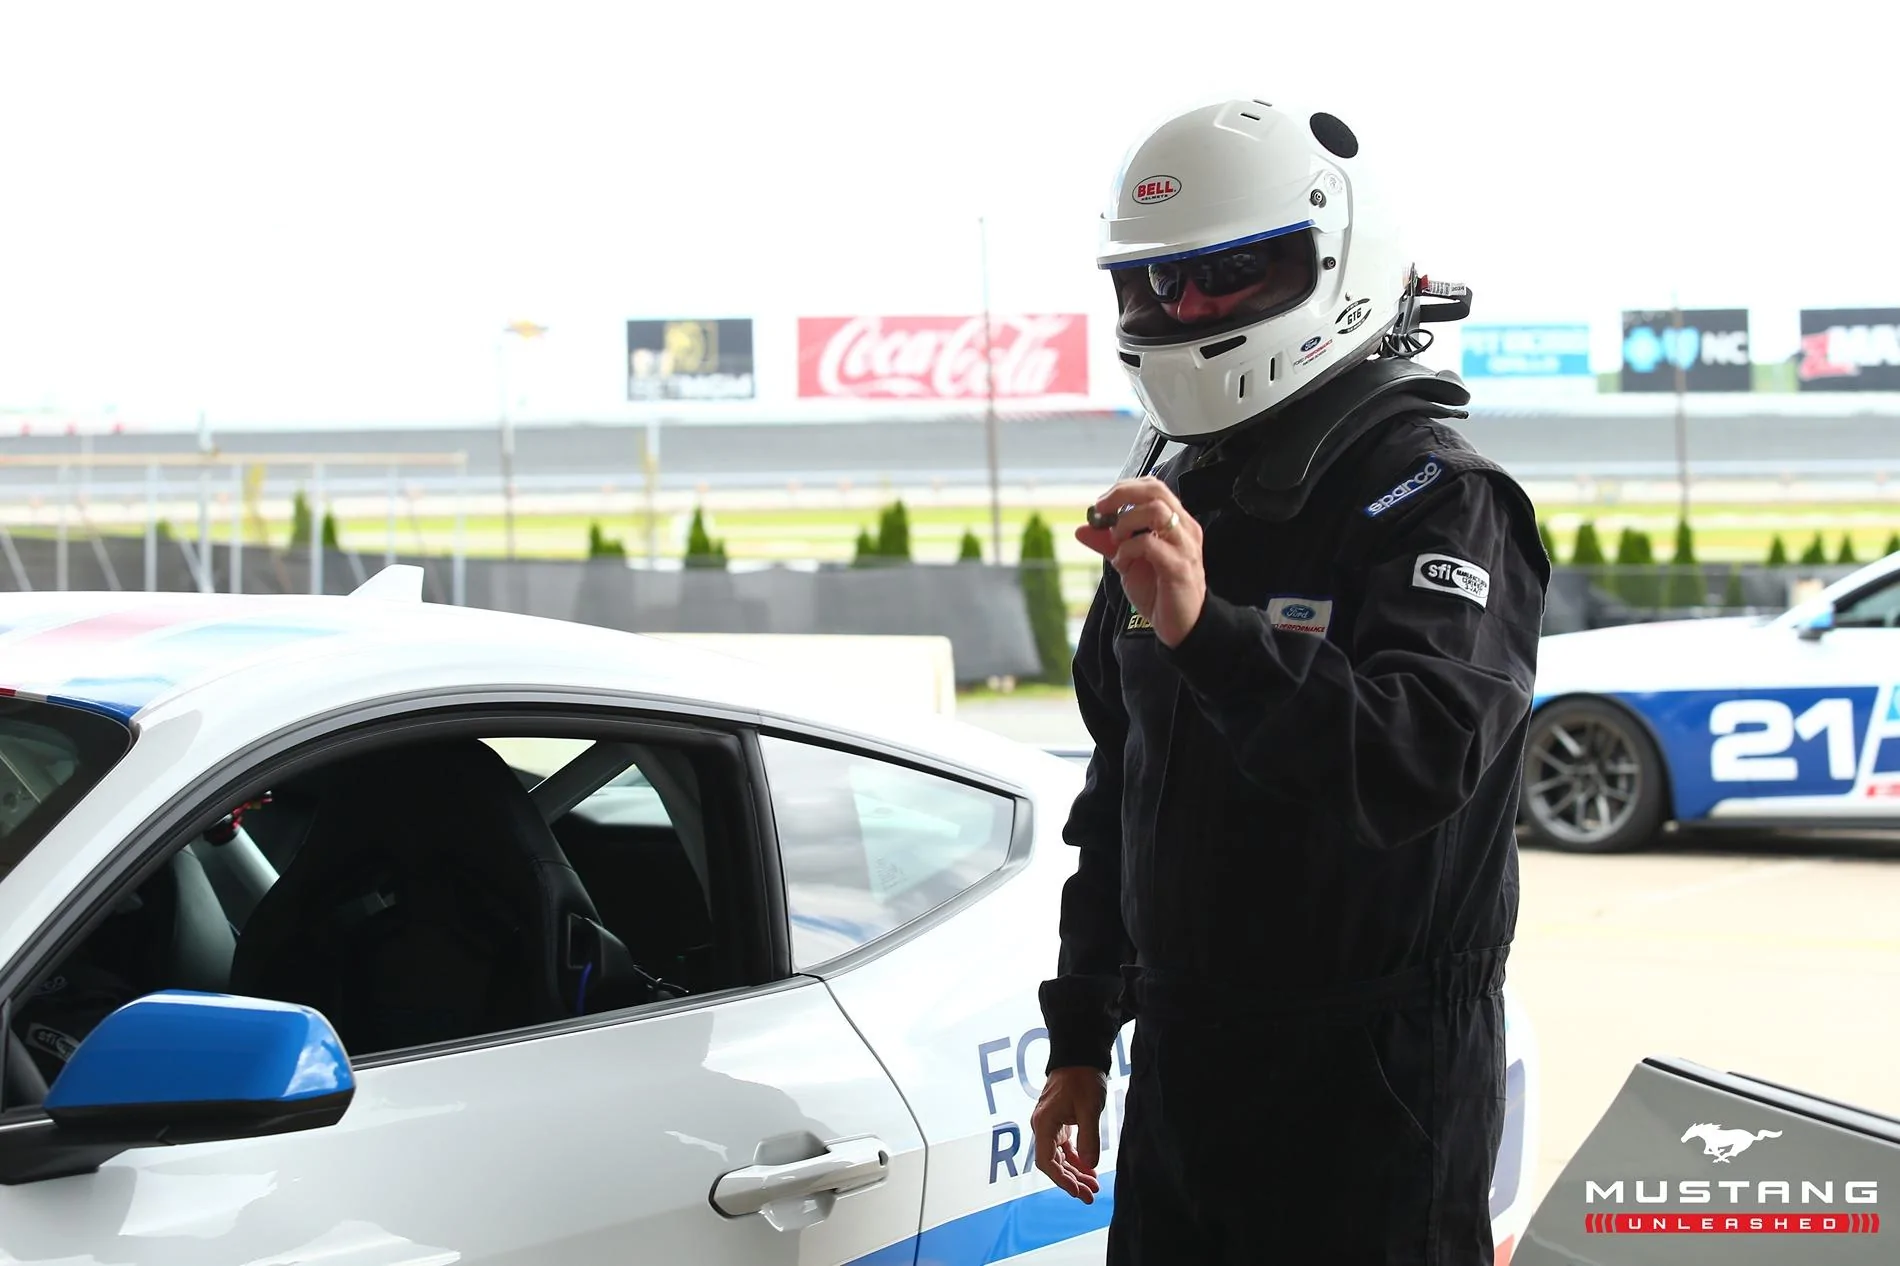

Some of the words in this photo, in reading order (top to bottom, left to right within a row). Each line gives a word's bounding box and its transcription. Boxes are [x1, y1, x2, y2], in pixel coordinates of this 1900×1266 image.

[1138, 181, 1174, 198] BELL
[1368, 462, 1438, 512] sparco
[1427, 563, 1452, 581] sfi
[1709, 697, 1857, 782] 21
